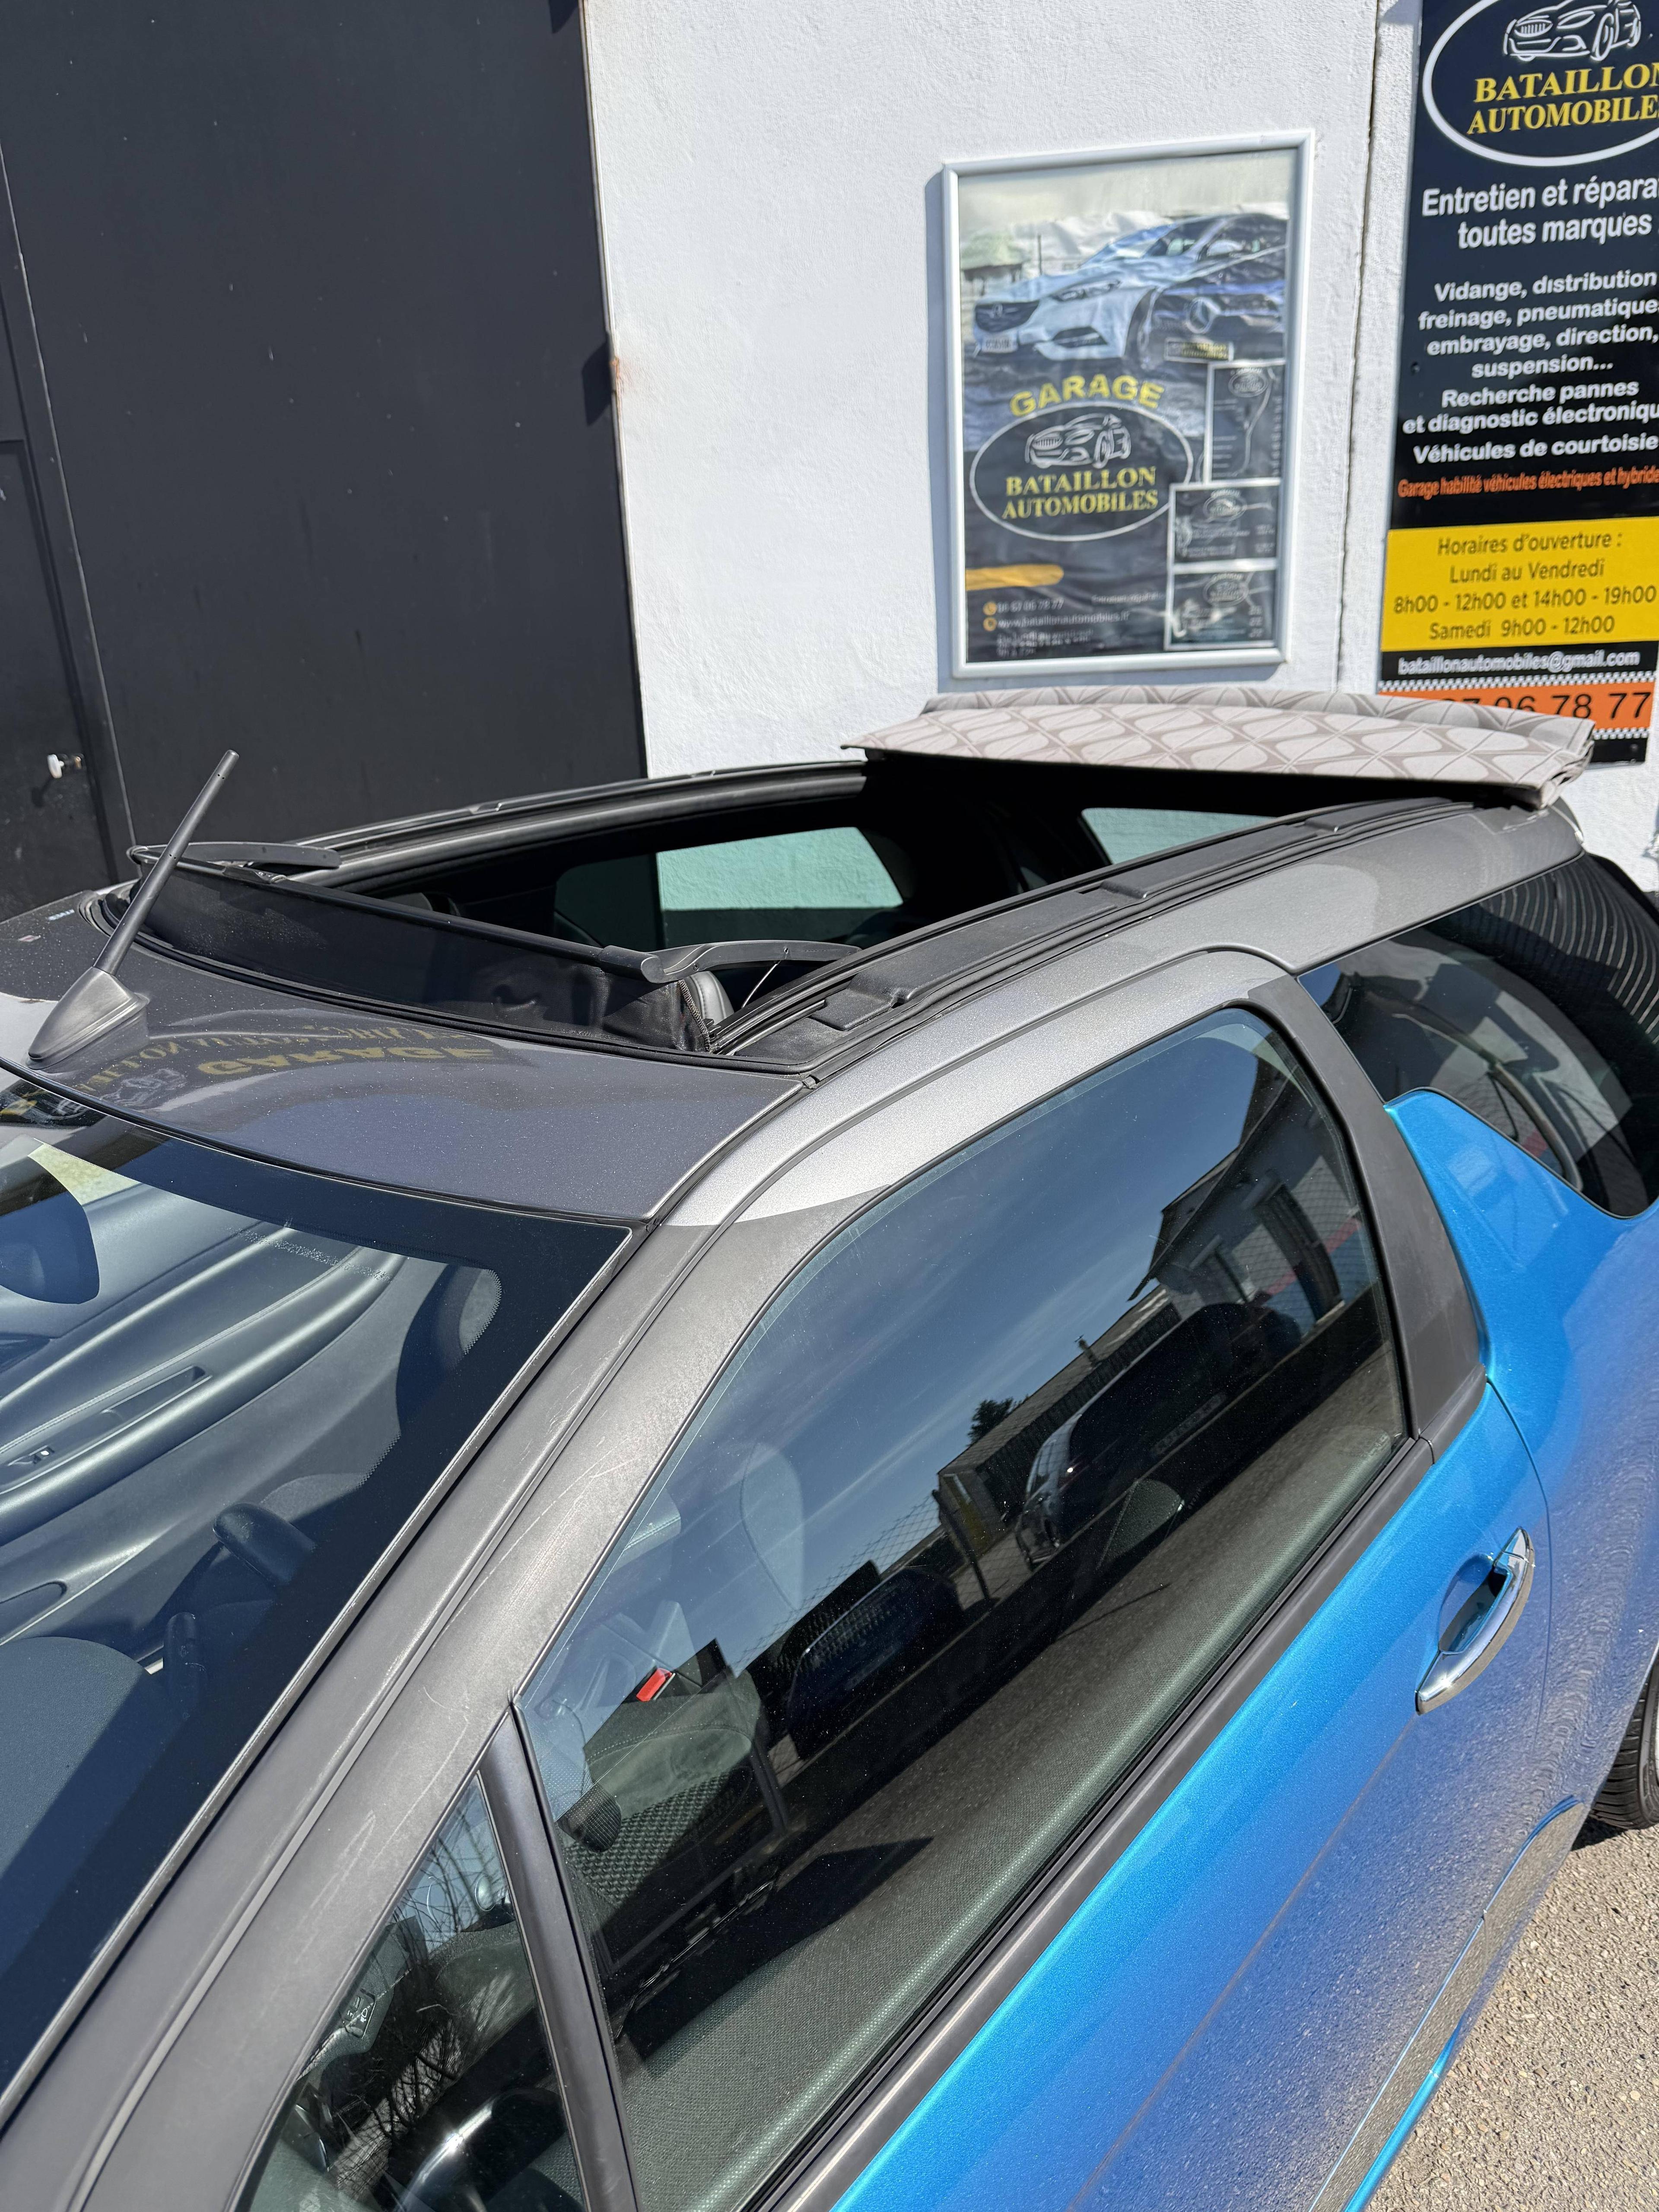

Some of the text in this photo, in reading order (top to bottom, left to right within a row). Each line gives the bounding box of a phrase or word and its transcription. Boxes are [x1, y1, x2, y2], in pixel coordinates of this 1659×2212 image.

[1467, 95, 1659, 134] AUTOMOBILE
[1422, 175, 1659, 216] Entretien et répara
[1458, 213, 1652, 249] toutes marques
[1434, 269, 1657, 302] Vidange, distribution
[1418, 297, 1659, 330] freinage, pneumatique
[1427, 324, 1659, 356] embrayage, direction,
[1471, 355, 1613, 380] suspension...
[1010, 374, 1165, 416] GARAGE
[1441, 381, 1640, 408] Recherche pannes
[1402, 416, 1425, 435] et
[1428, 409, 1538, 434] diagnostic
[1414, 432, 1659, 464] Véhicules de courtoisie
[1006, 466, 1156, 496] BATAILLON
[1398, 479, 1439, 500] Garage
[1440, 475, 1482, 496] habilité
[1484, 473, 1537, 493] véhicules
[1538, 469, 1602, 492] électriques
[1603, 467, 1616, 486] et
[1001, 489, 1159, 519] AUTOMOBILES
[1438, 535, 1507, 555] Horaires
[1450, 558, 1605, 583] Lundi au Vendredi
[1393, 595, 1439, 613] 8h00
[1456, 592, 1506, 610] 12h00
[1512, 595, 1528, 609] et
[1534, 588, 1586, 607] 14h00
[1605, 585, 1657, 604] 19h00
[1429, 620, 1491, 640] Samedi
[1501, 618, 1547, 637] 9h00
[1564, 615, 1615, 634] 12h00
[1398, 651, 1640, 674] bataillonautomobiles@gmail.com
[1608, 692, 1651, 720] 77
